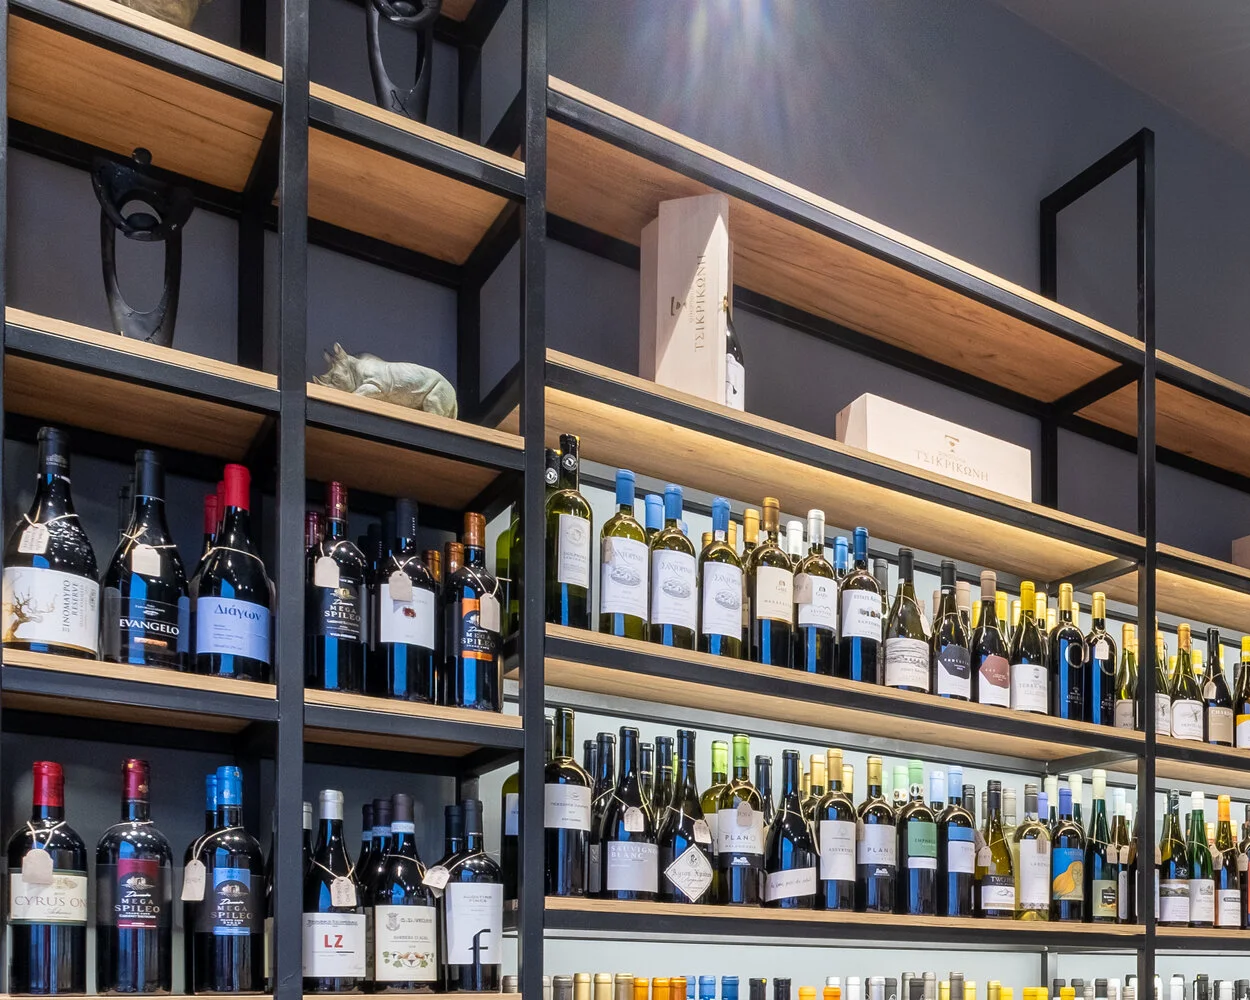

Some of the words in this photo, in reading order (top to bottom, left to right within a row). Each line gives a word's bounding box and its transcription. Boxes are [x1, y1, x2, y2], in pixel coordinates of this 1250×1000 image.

[214, 603, 262, 621] Διάγων
[330, 605, 357, 614] MEGA
[324, 610, 361, 622] SPILEO
[466, 632, 491, 640] MEGA
[460, 637, 497, 648] SPILEO
[14, 895, 66, 907] CYRUS
[115, 904, 160, 913] SPILEO
[211, 911, 252, 920] SPILEO
[324, 934, 344, 948] LZ
